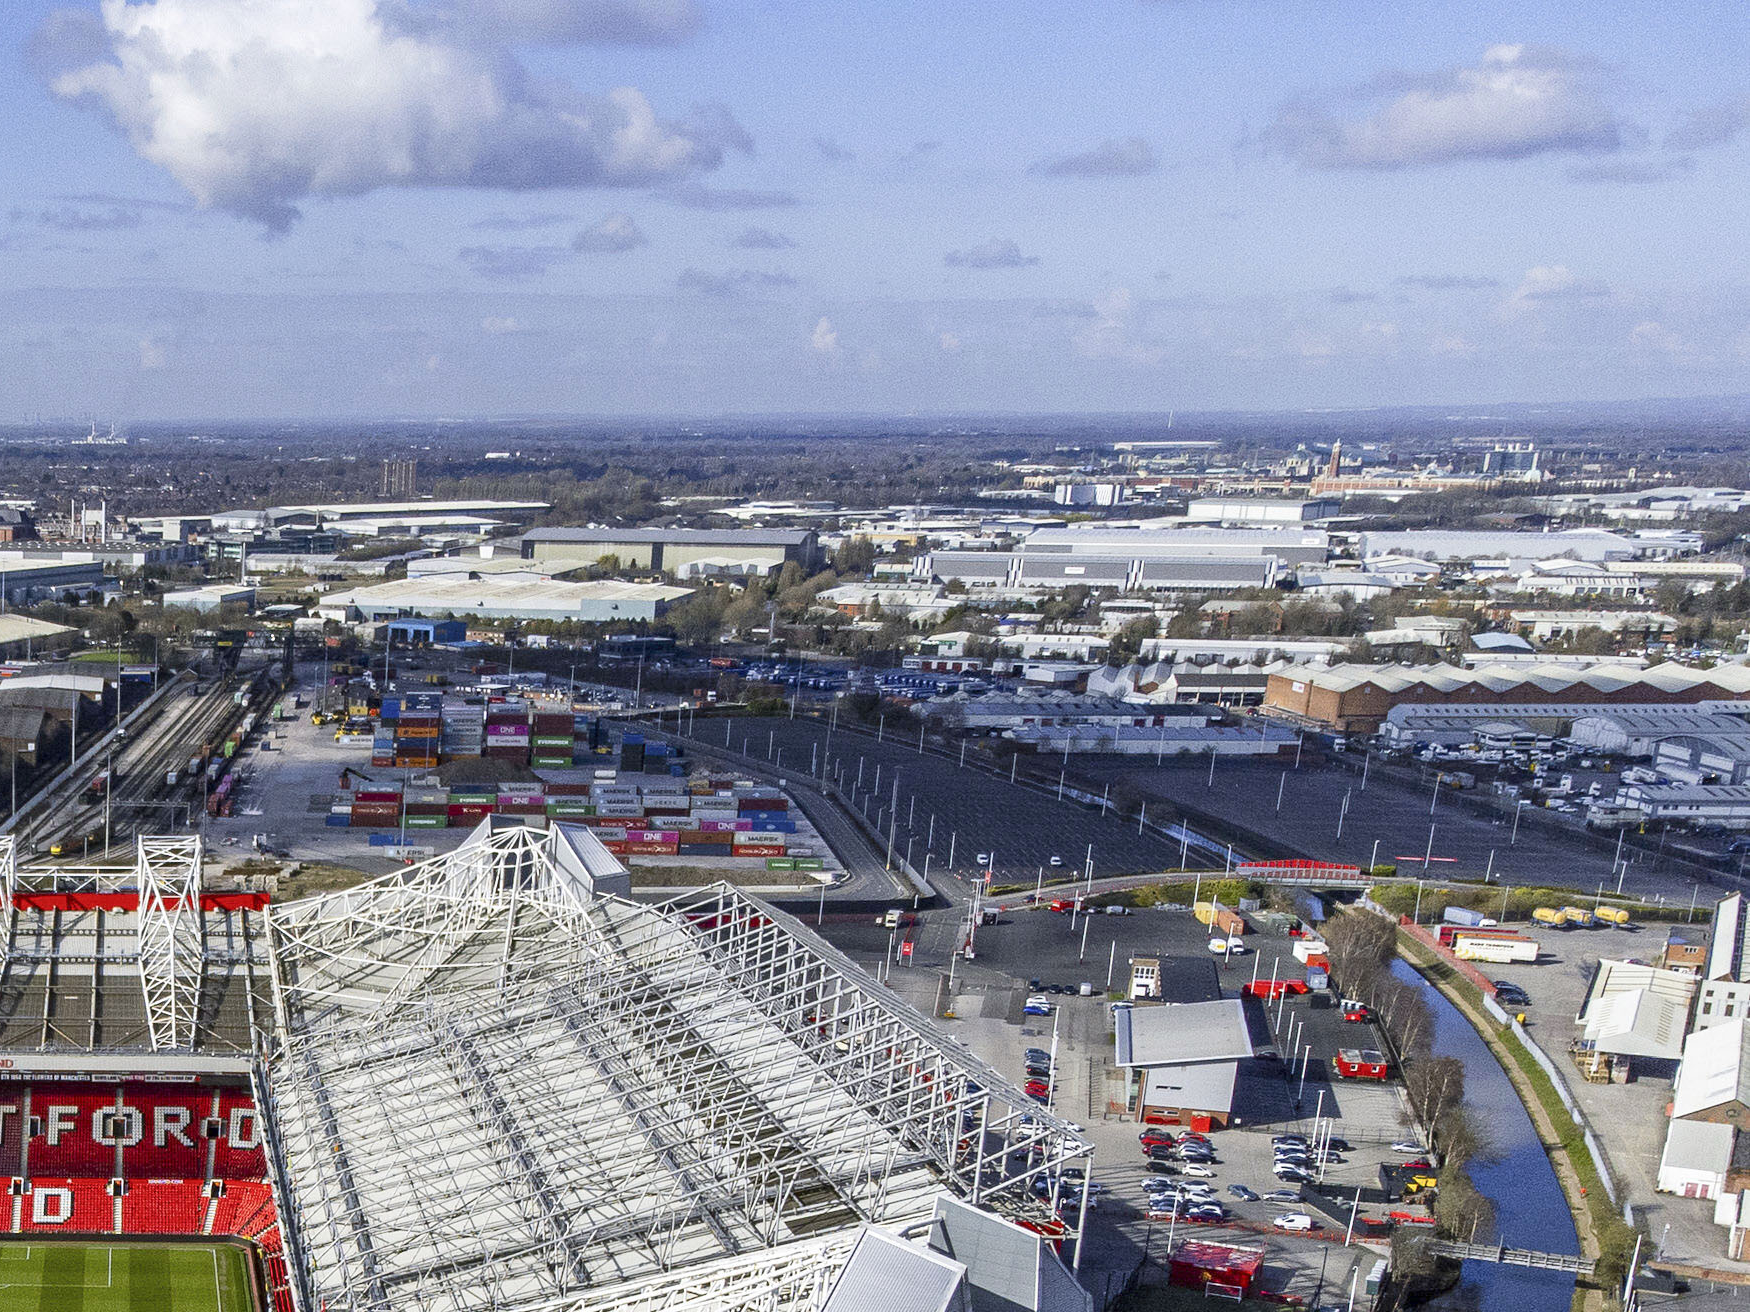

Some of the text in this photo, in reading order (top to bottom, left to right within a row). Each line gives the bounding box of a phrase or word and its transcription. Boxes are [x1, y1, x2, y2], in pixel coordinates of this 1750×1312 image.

[500, 726, 516, 735] ONE
[717, 822, 737, 830] ONE
[643, 833, 662, 841] ONE
